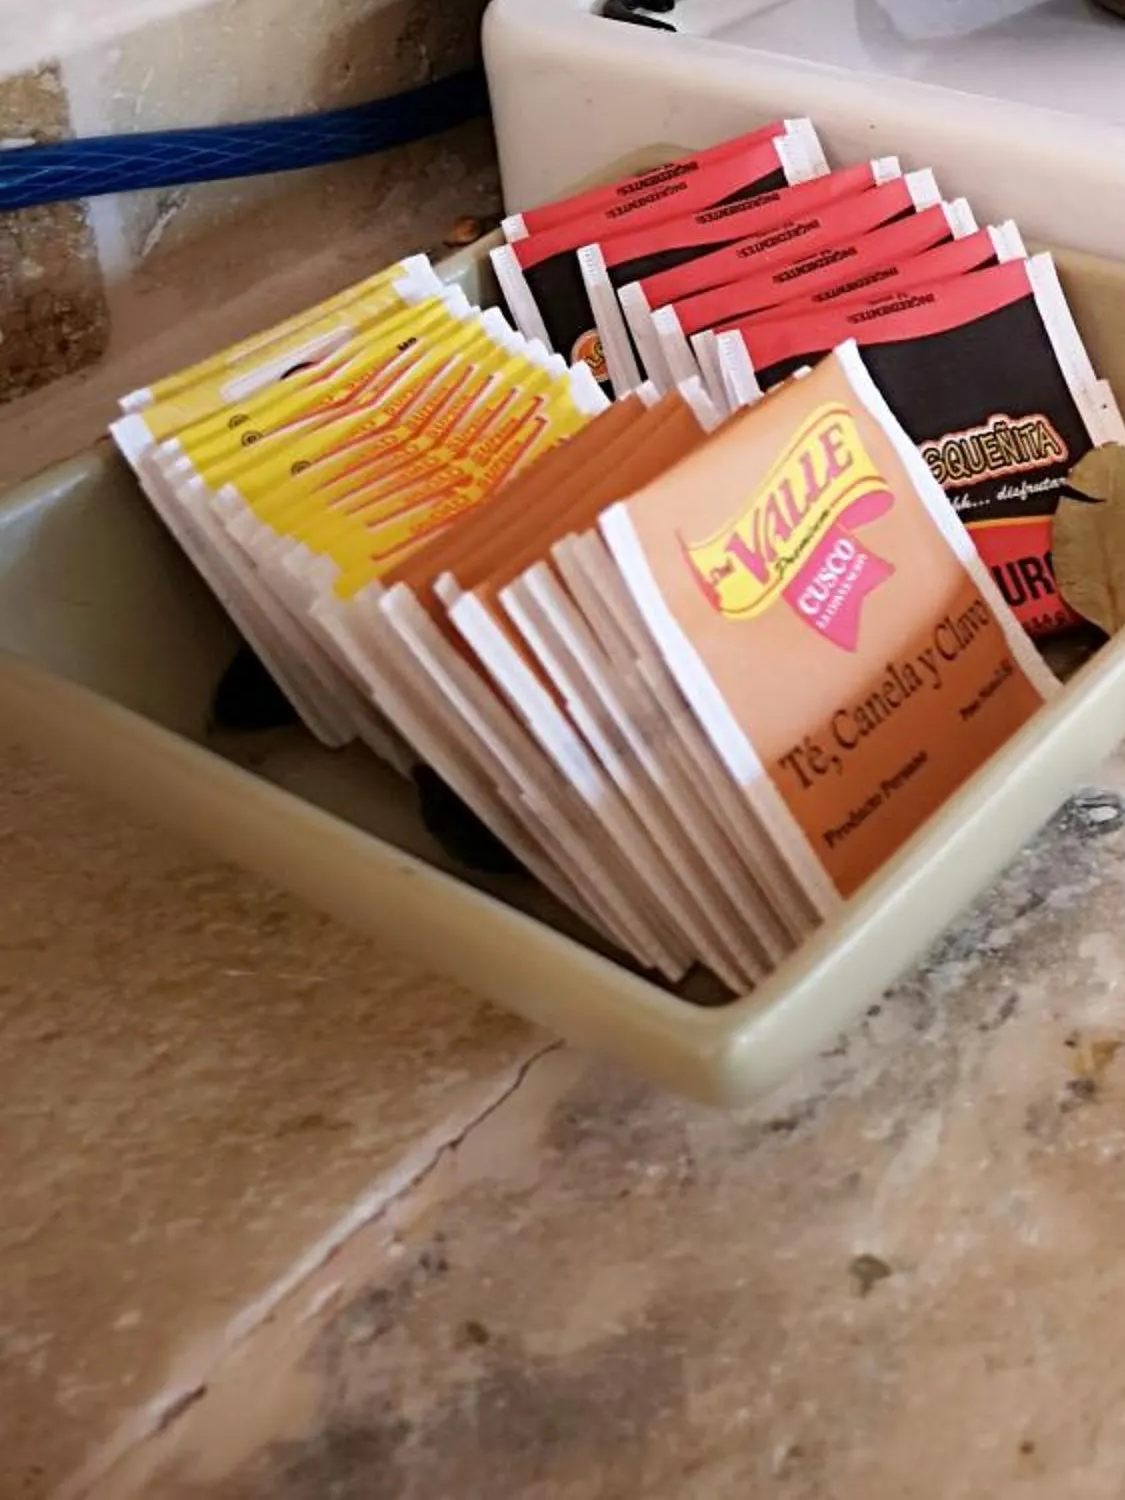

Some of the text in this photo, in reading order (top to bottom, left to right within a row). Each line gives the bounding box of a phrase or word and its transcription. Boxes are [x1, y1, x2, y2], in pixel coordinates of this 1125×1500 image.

[724, 422, 854, 587] VALLE
[798, 538, 855, 616] CUSCO
[831, 661, 923, 751] Canela
[917, 647, 943, 690] y
